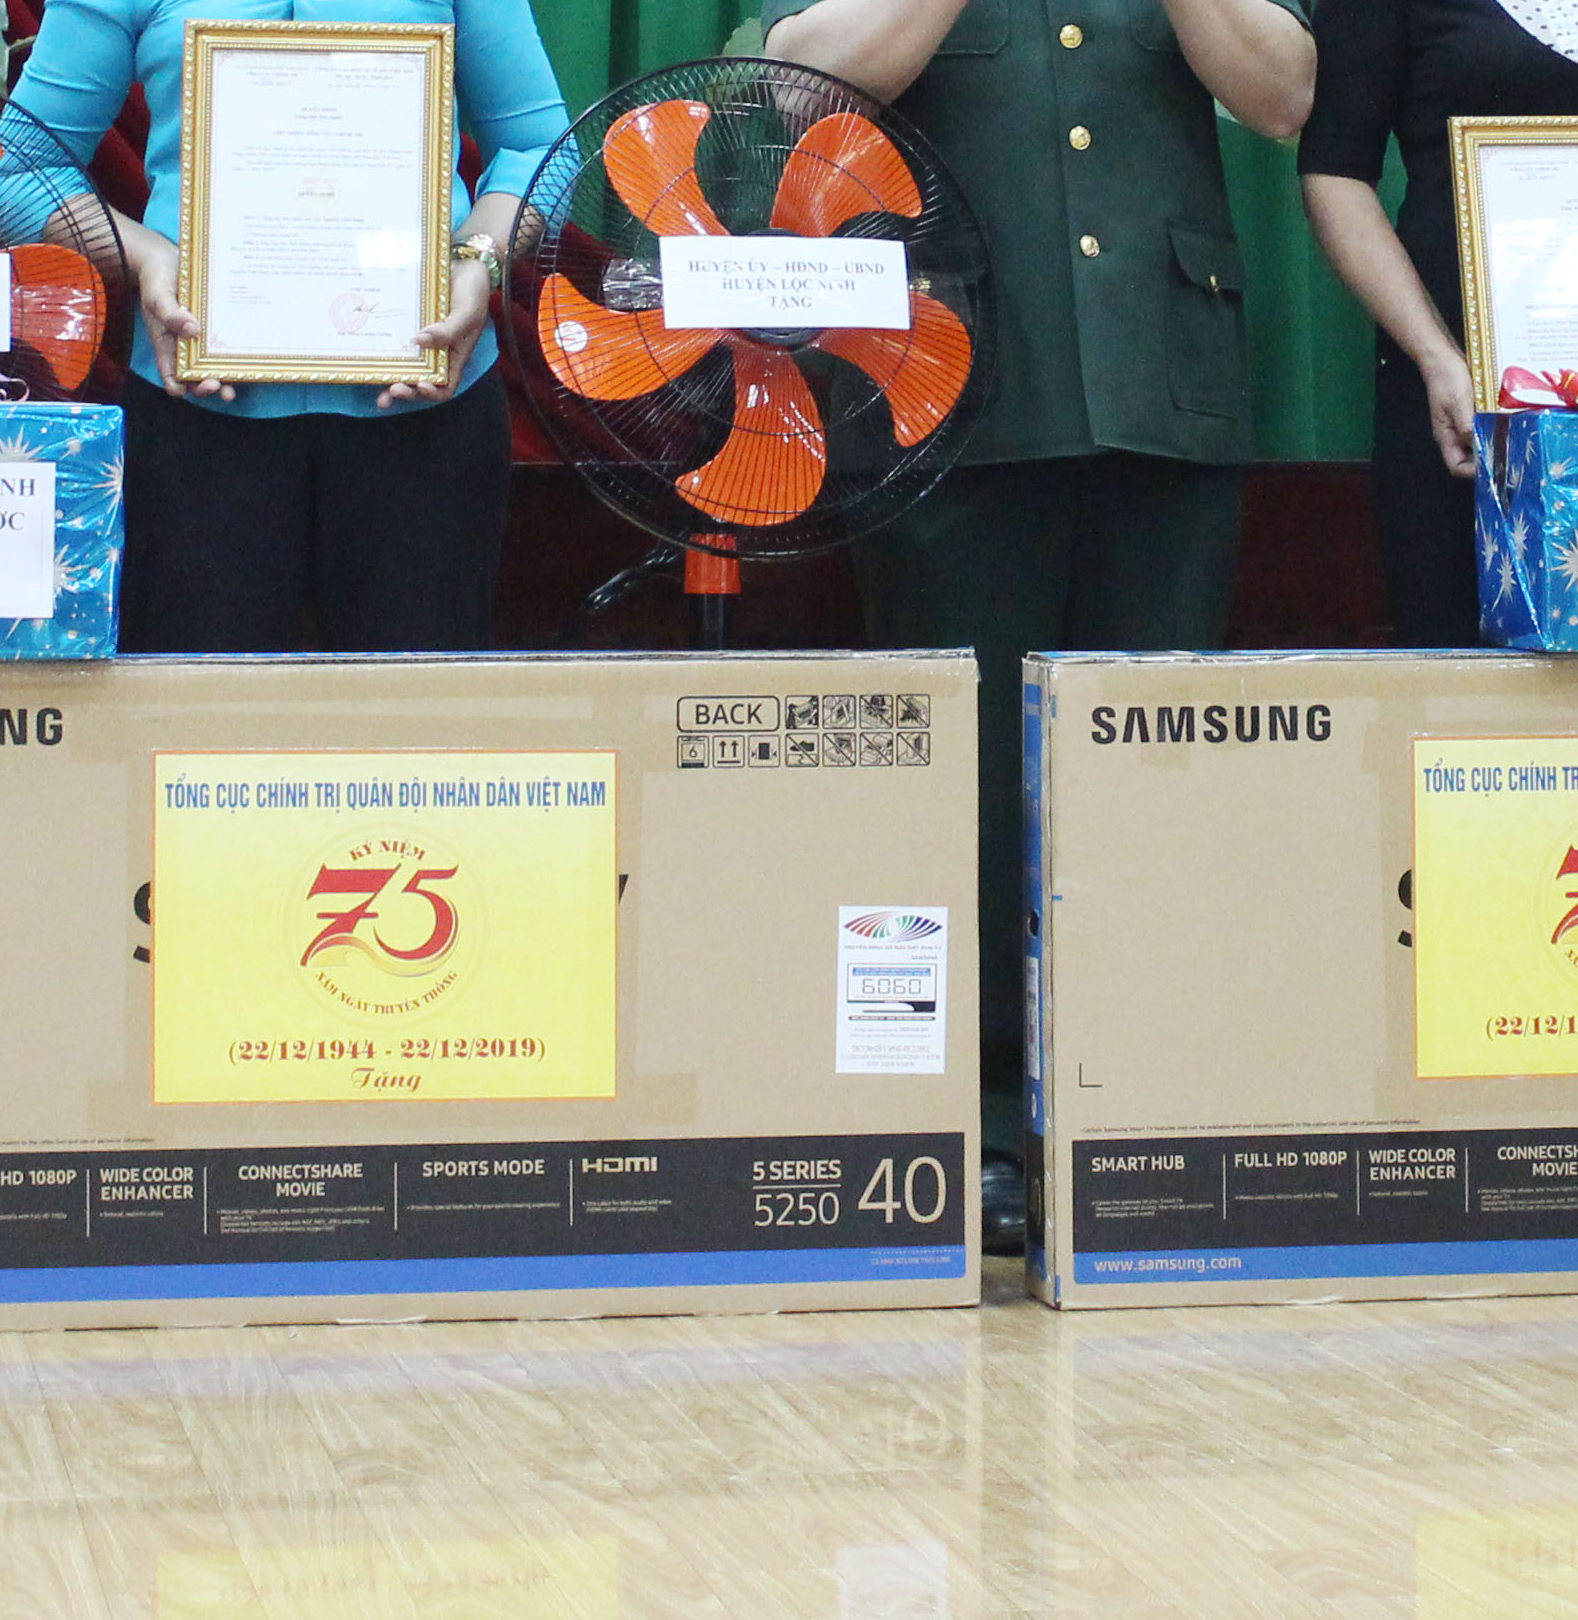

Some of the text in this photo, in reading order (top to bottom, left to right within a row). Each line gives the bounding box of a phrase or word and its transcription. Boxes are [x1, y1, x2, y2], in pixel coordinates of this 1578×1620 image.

[695, 703, 762, 726] BACK
[1091, 704, 1332, 745] SAMSUNG
[165, 773, 605, 814] TỔNG CỤC CHÍNH TRỊ QUÂN ĐỘI NHÂN DÂN VIỆT NAM
[300, 863, 459, 967] 75
[582, 1156, 658, 1173] HDMI
[1091, 1155, 1185, 1173] SMART HUB
[1235, 1151, 1347, 1169] FULL HD 1080P
[1368, 1148, 1456, 1164] WIDE COLOR
[100, 1167, 194, 1184] WIDE COLOR
[239, 1163, 363, 1180] CONNECTSHARE
[422, 1159, 545, 1178] SPORTS MODE
[752, 1159, 841, 1181] 5 SERIES
[1370, 1164, 1456, 1181] ENHANCER
[1, 1171, 23, 1186] HD
[28, 1170, 76, 1186] 1080P
[100, 1184, 194, 1201] ENHANCER
[276, 1181, 325, 1197] MOVIE
[858, 1156, 946, 1224] 40
[753, 1192, 840, 1227] 5250
[1095, 1255, 1241, 1273] www.samsung.com
